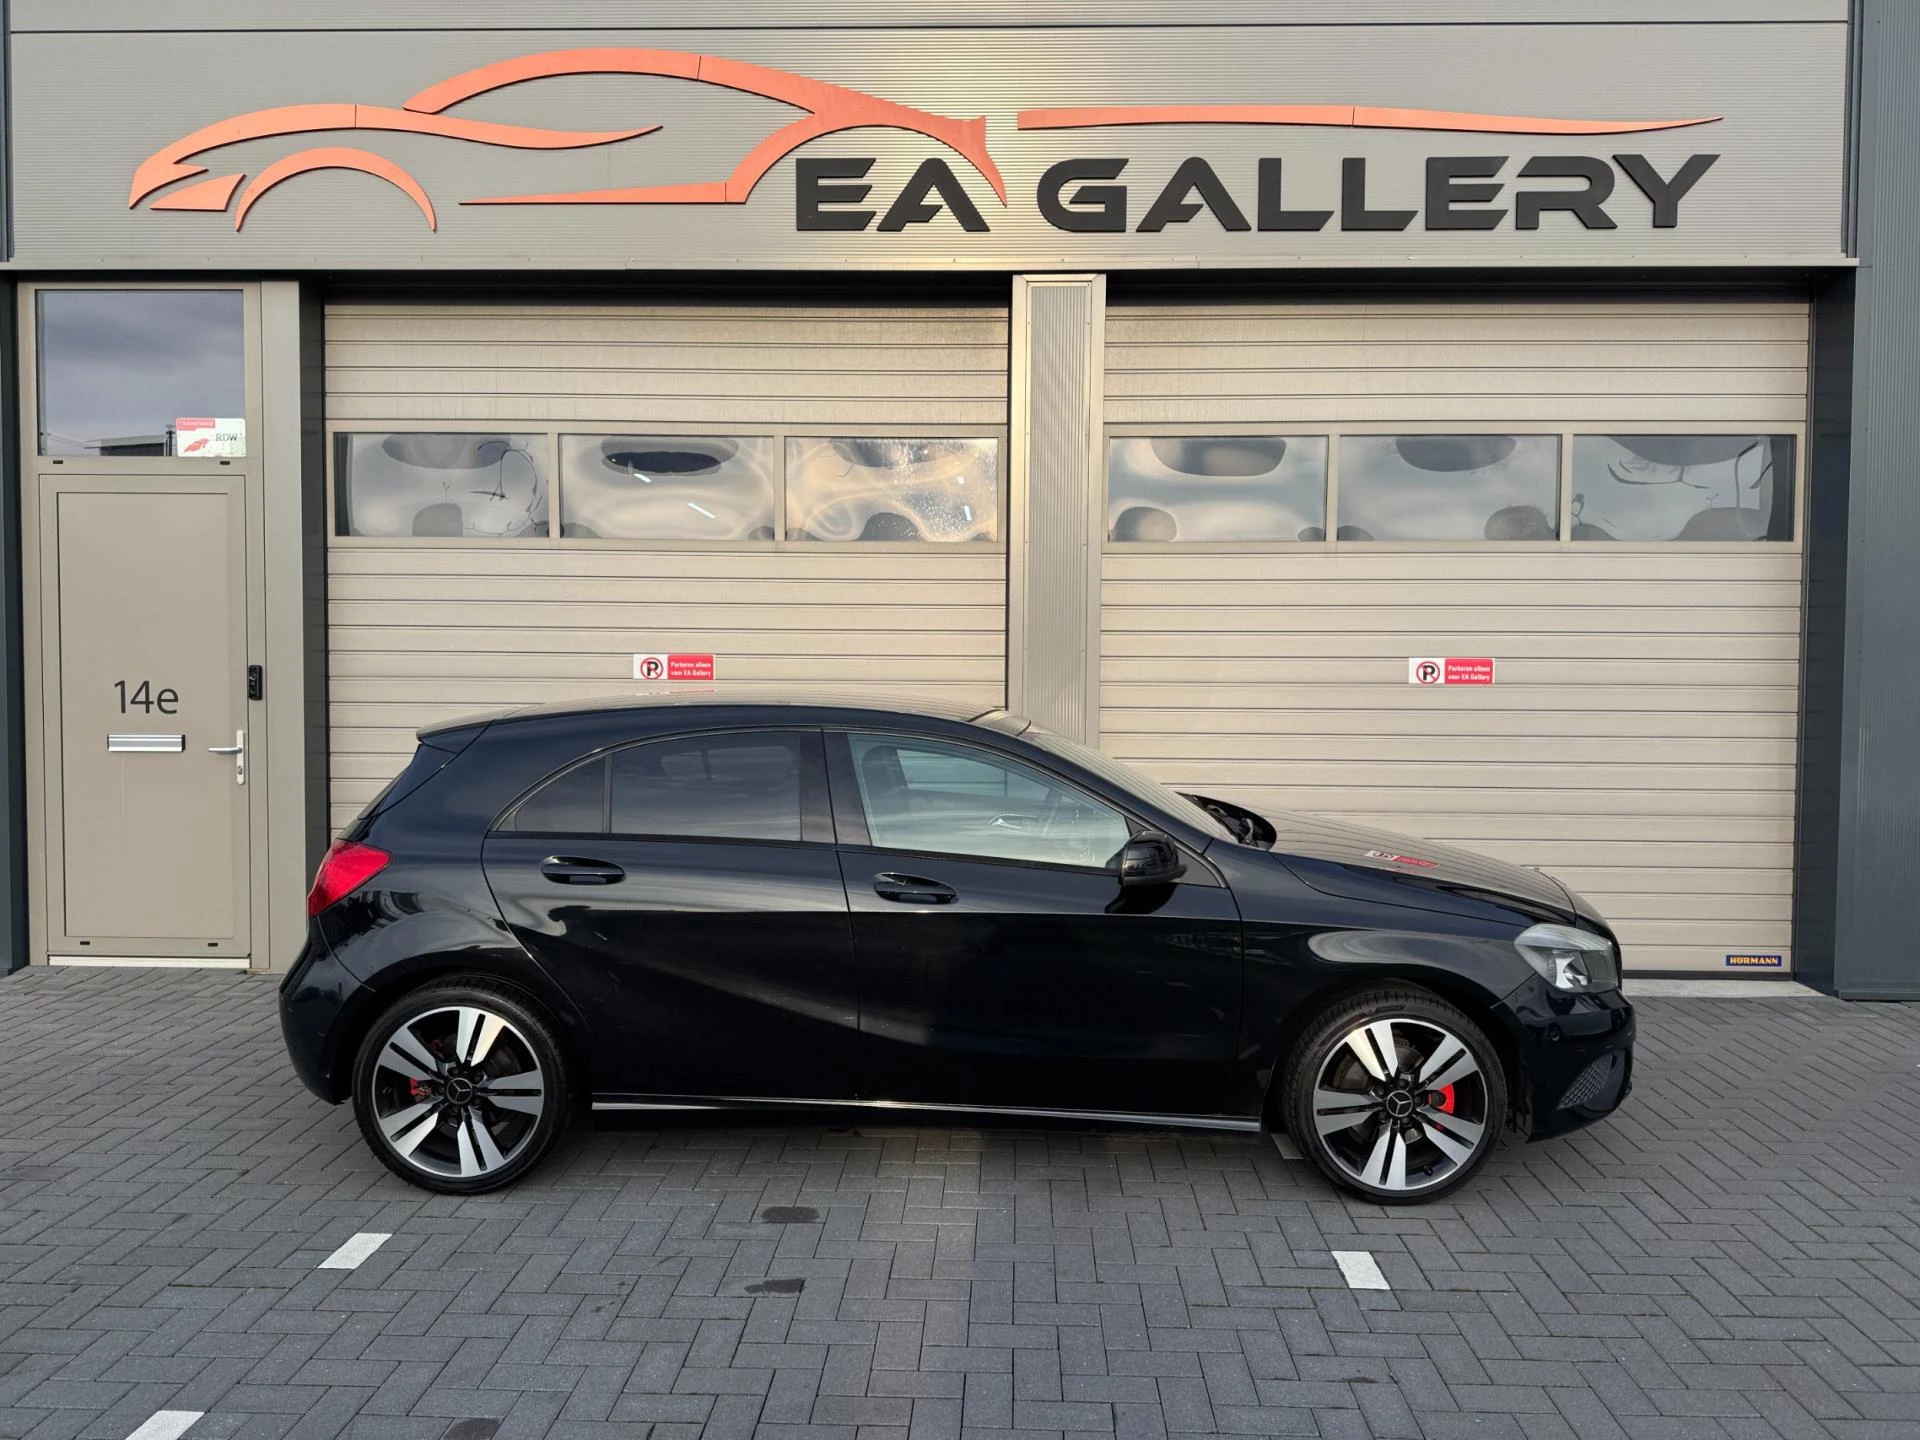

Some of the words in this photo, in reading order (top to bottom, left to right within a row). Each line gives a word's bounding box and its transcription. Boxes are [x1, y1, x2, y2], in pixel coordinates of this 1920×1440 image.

[796, 158, 991, 232] EA
[1037, 153, 1721, 232] GALLERY
[215, 433, 238, 442] RDW
[114, 680, 179, 714] 14e
